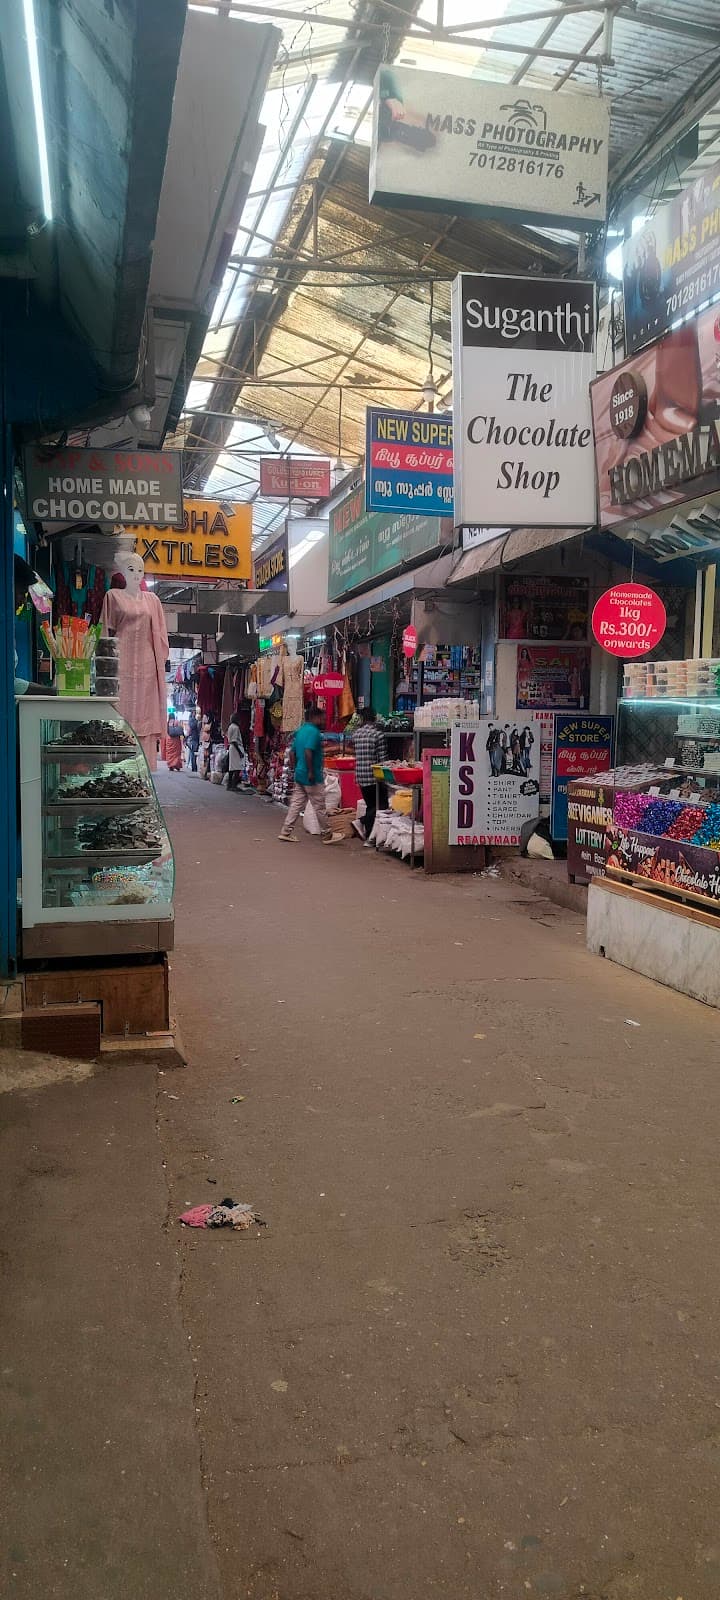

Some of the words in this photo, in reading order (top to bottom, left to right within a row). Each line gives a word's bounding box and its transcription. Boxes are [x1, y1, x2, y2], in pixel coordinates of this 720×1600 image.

[425, 113, 477, 138] MASS
[479, 122, 604, 156] PHOTOGRAPHY
[468, 152, 565, 179] 7012816176
[666, 263, 720, 316] 701281617
[465, 298, 592, 346] Suganthi
[506, 372, 554, 403] The
[612, 388, 634, 408] Since
[614, 405, 634, 426] 1918
[377, 417, 409, 442] NEW
[466, 415, 592, 448] Chocolate
[49, 477, 103, 494] HOME
[109, 479, 161, 496] MADE
[496, 461, 560, 498] Shop
[32, 498, 179, 522] CHOCOLATE
[134, 540, 240, 568] XTILES
[609, 598, 653, 607] Chocolates
[610, 590, 653, 600] Homemade
[619, 606, 641, 622] 1kg
[600, 621, 658, 638] Rs.300/-
[603, 639, 651, 650] onwards
[558, 721, 579, 741] NEW
[580, 720, 611, 742] SUPER
[567, 733, 600, 744] STORE
[575, 827, 603, 850] LOTTERY
